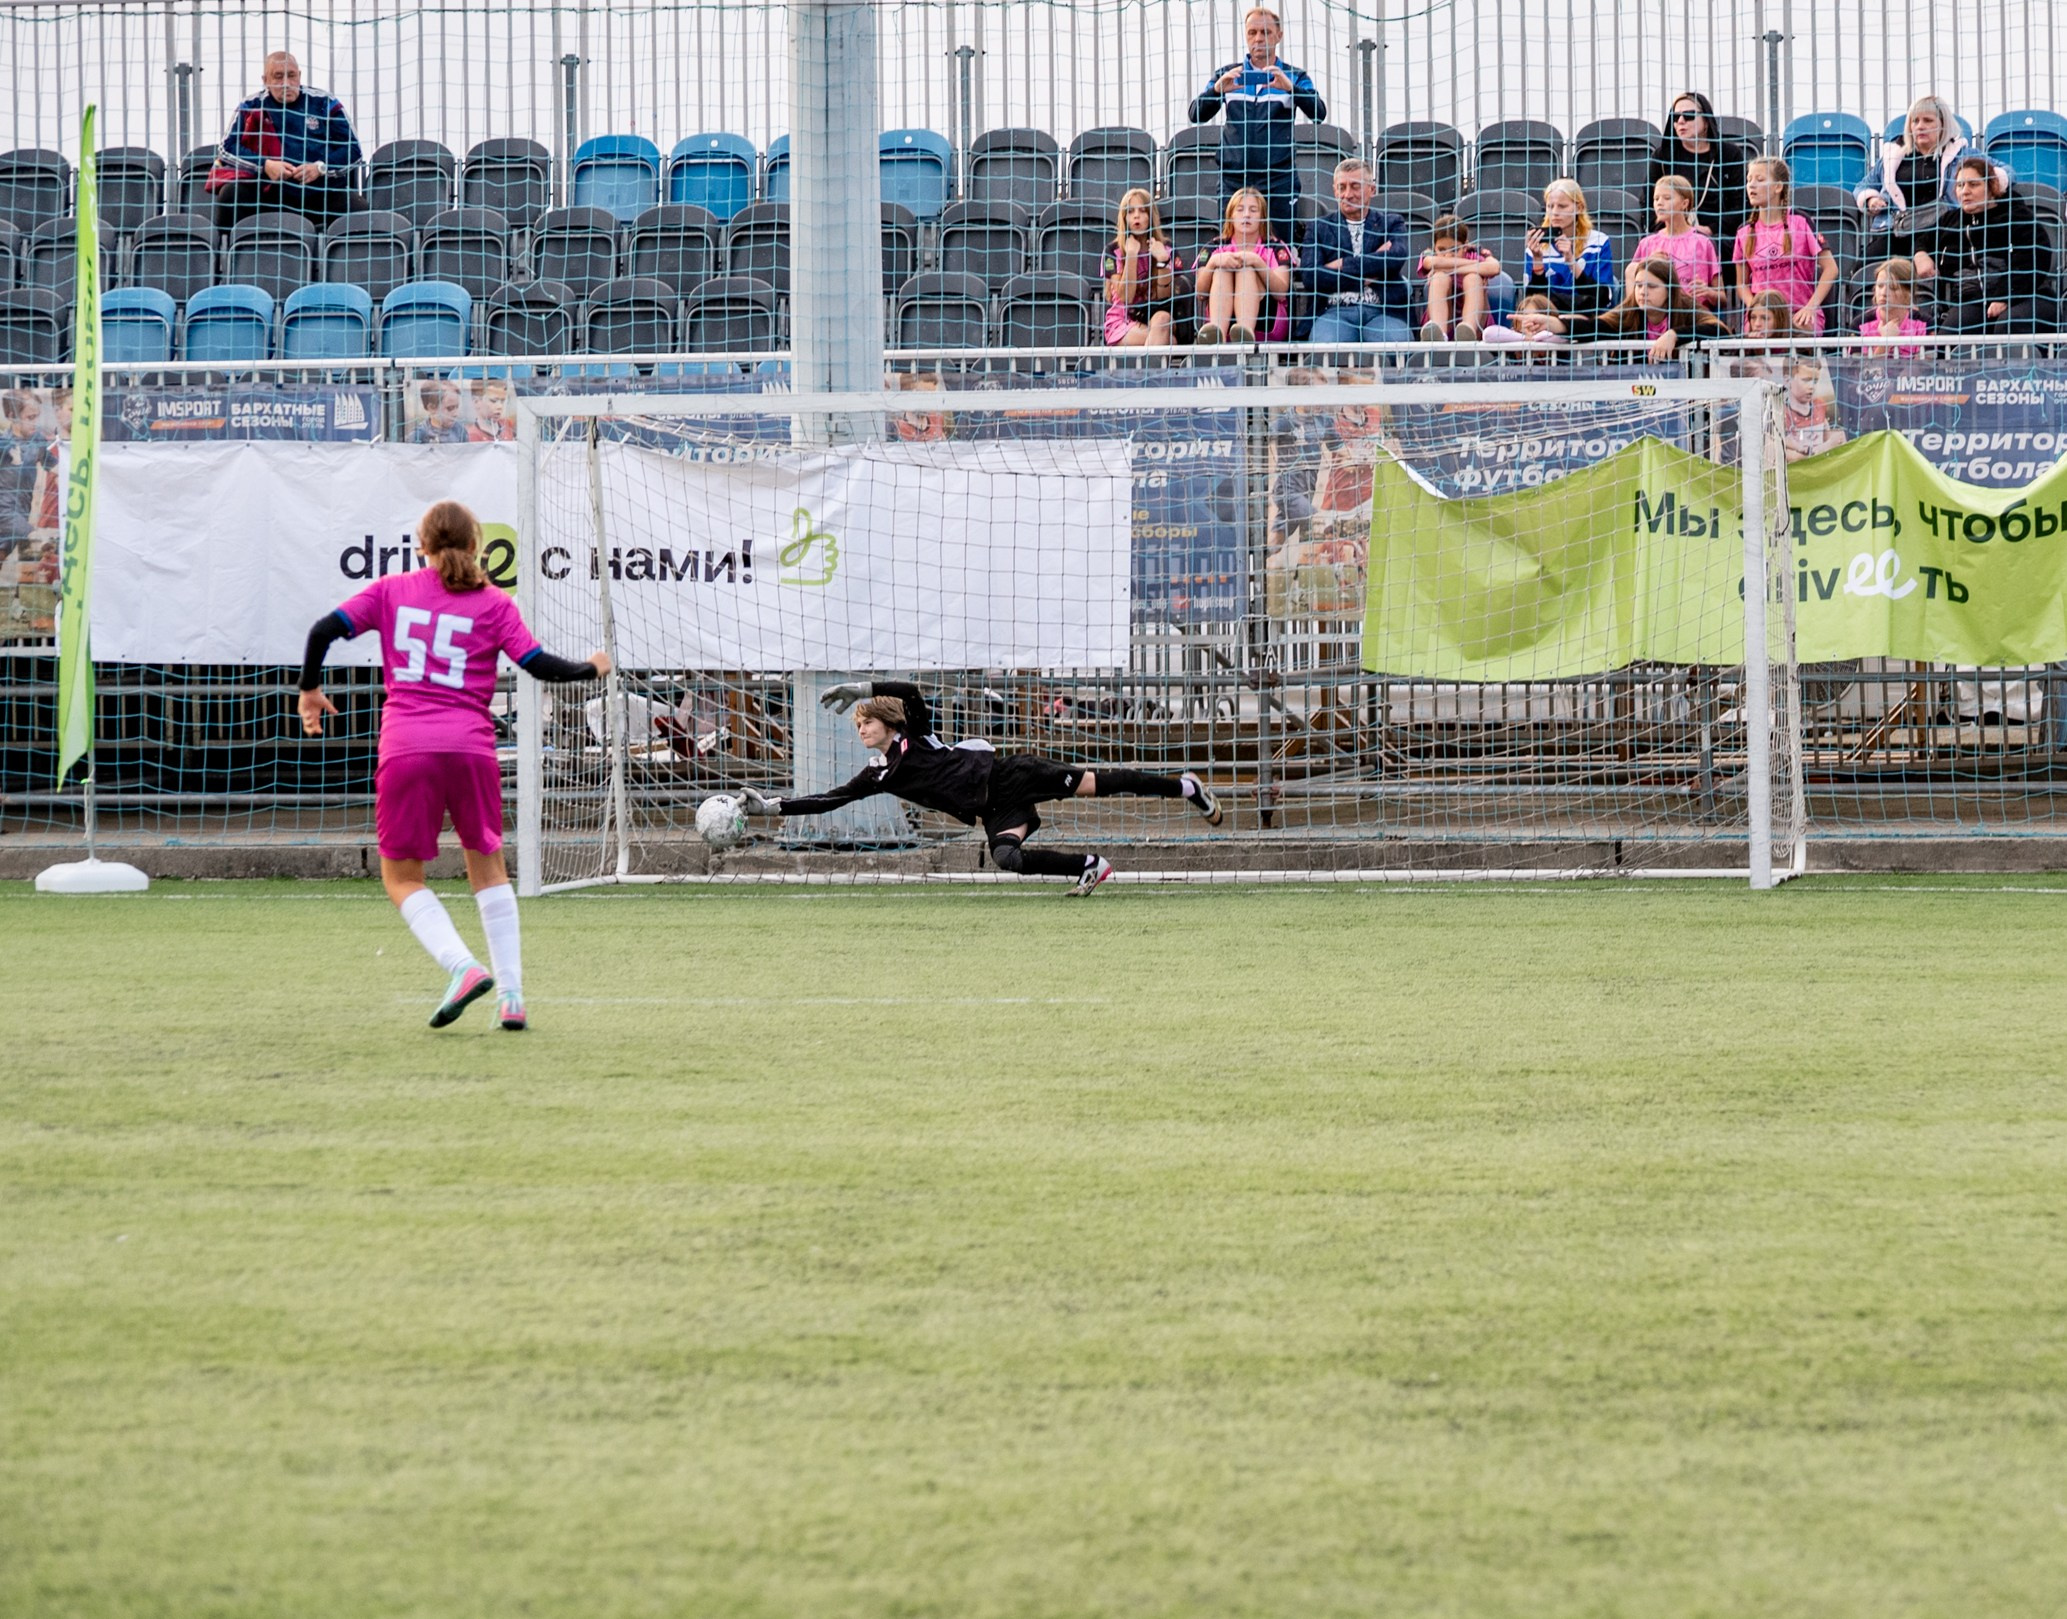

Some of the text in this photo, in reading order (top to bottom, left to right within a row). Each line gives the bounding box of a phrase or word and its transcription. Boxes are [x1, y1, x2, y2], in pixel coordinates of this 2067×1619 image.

[1633, 385, 1655, 396] SW
[1896, 376, 1965, 392] IMSPORT
[1975, 392, 2045, 405] СЕЗОНЫ
[157, 400, 222, 418] IMSPORT
[230, 402, 326, 416] БАРХАТНЫЕ
[231, 415, 294, 428] СЕЗОНЫ
[1132, 439, 1233, 464] тория
[1456, 437, 1676, 463] Территор
[1634, 489, 1720, 539] Мы
[1738, 497, 1902, 547] десь,
[541, 546, 571, 580] с
[590, 539, 753, 584] нами!
[392, 605, 474, 689] 55
